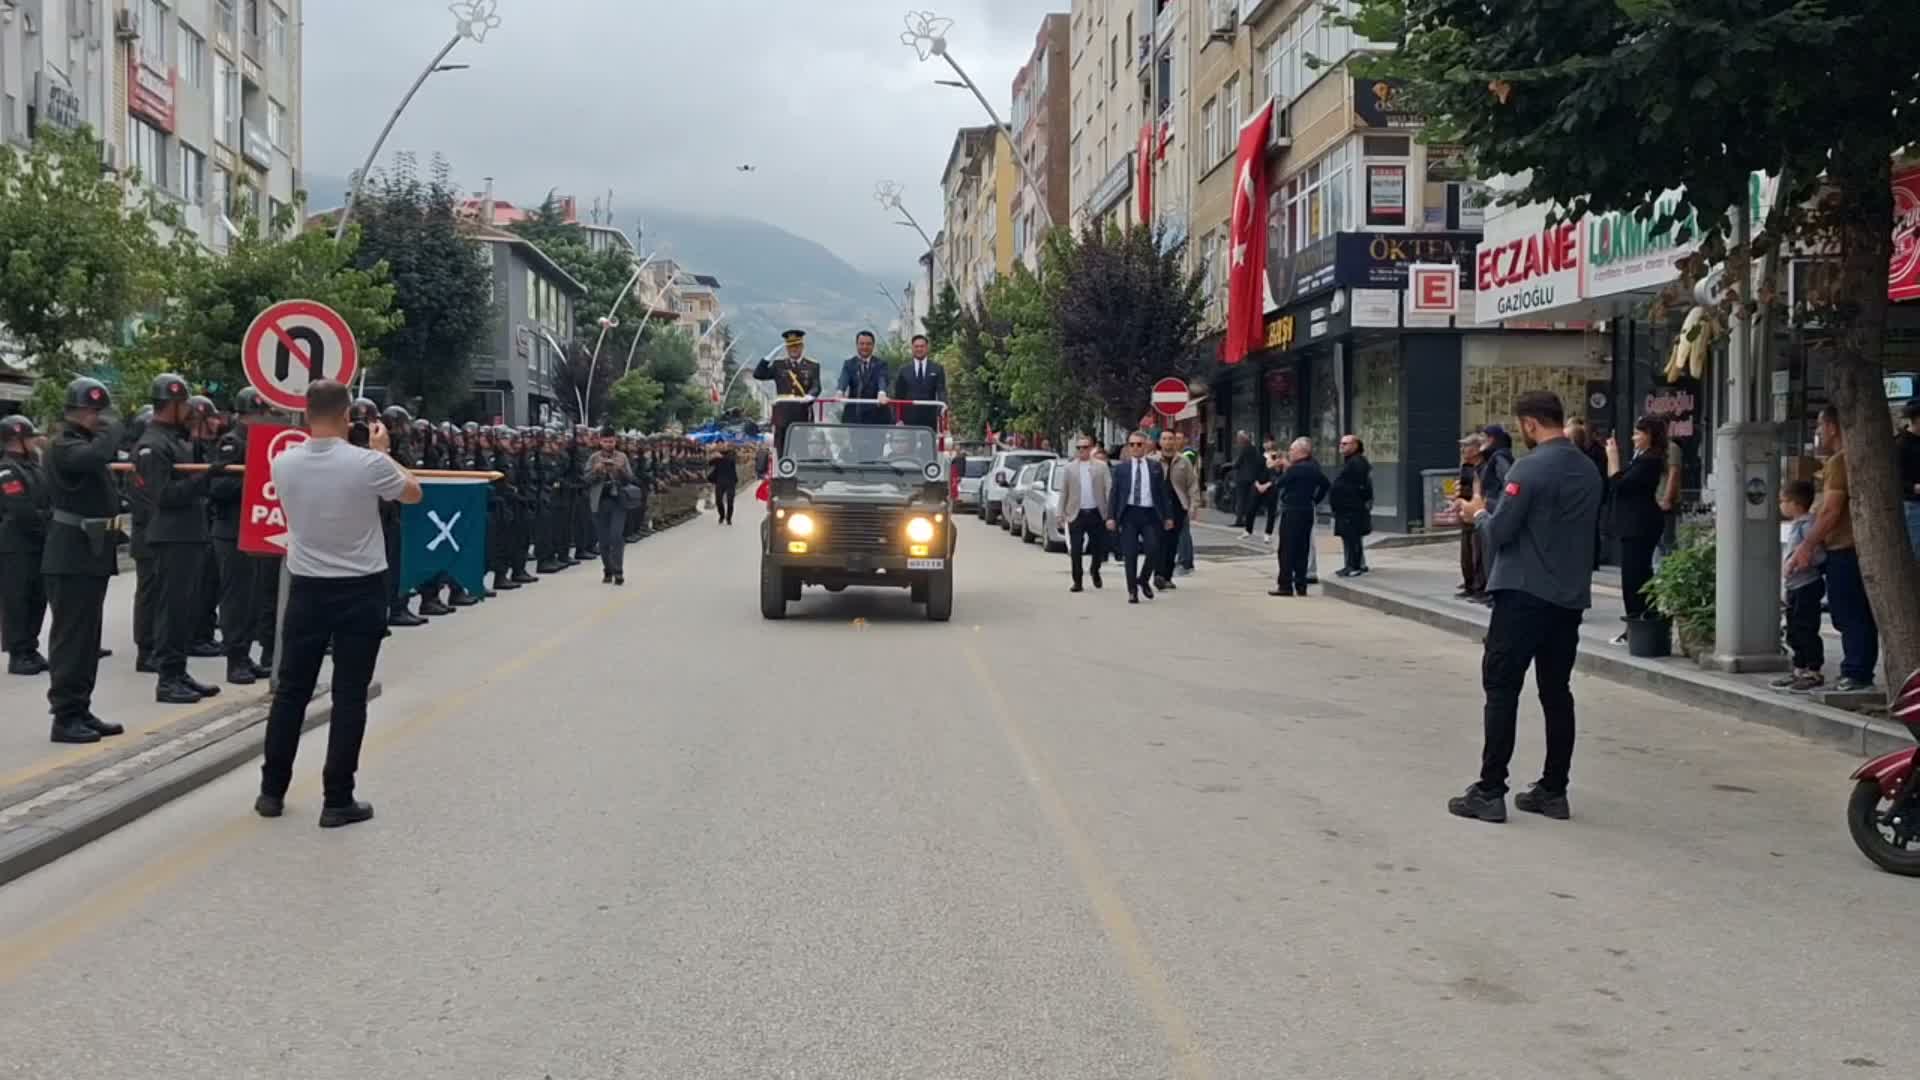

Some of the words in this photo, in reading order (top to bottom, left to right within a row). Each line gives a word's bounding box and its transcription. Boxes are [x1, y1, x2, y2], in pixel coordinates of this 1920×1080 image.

[1369, 233, 1469, 260] ÖKTEM
[1479, 223, 1577, 291] ECZANE
[1423, 275, 1448, 304] E
[1498, 285, 1555, 314] GAZİOĞLU
[251, 504, 287, 527] PA
